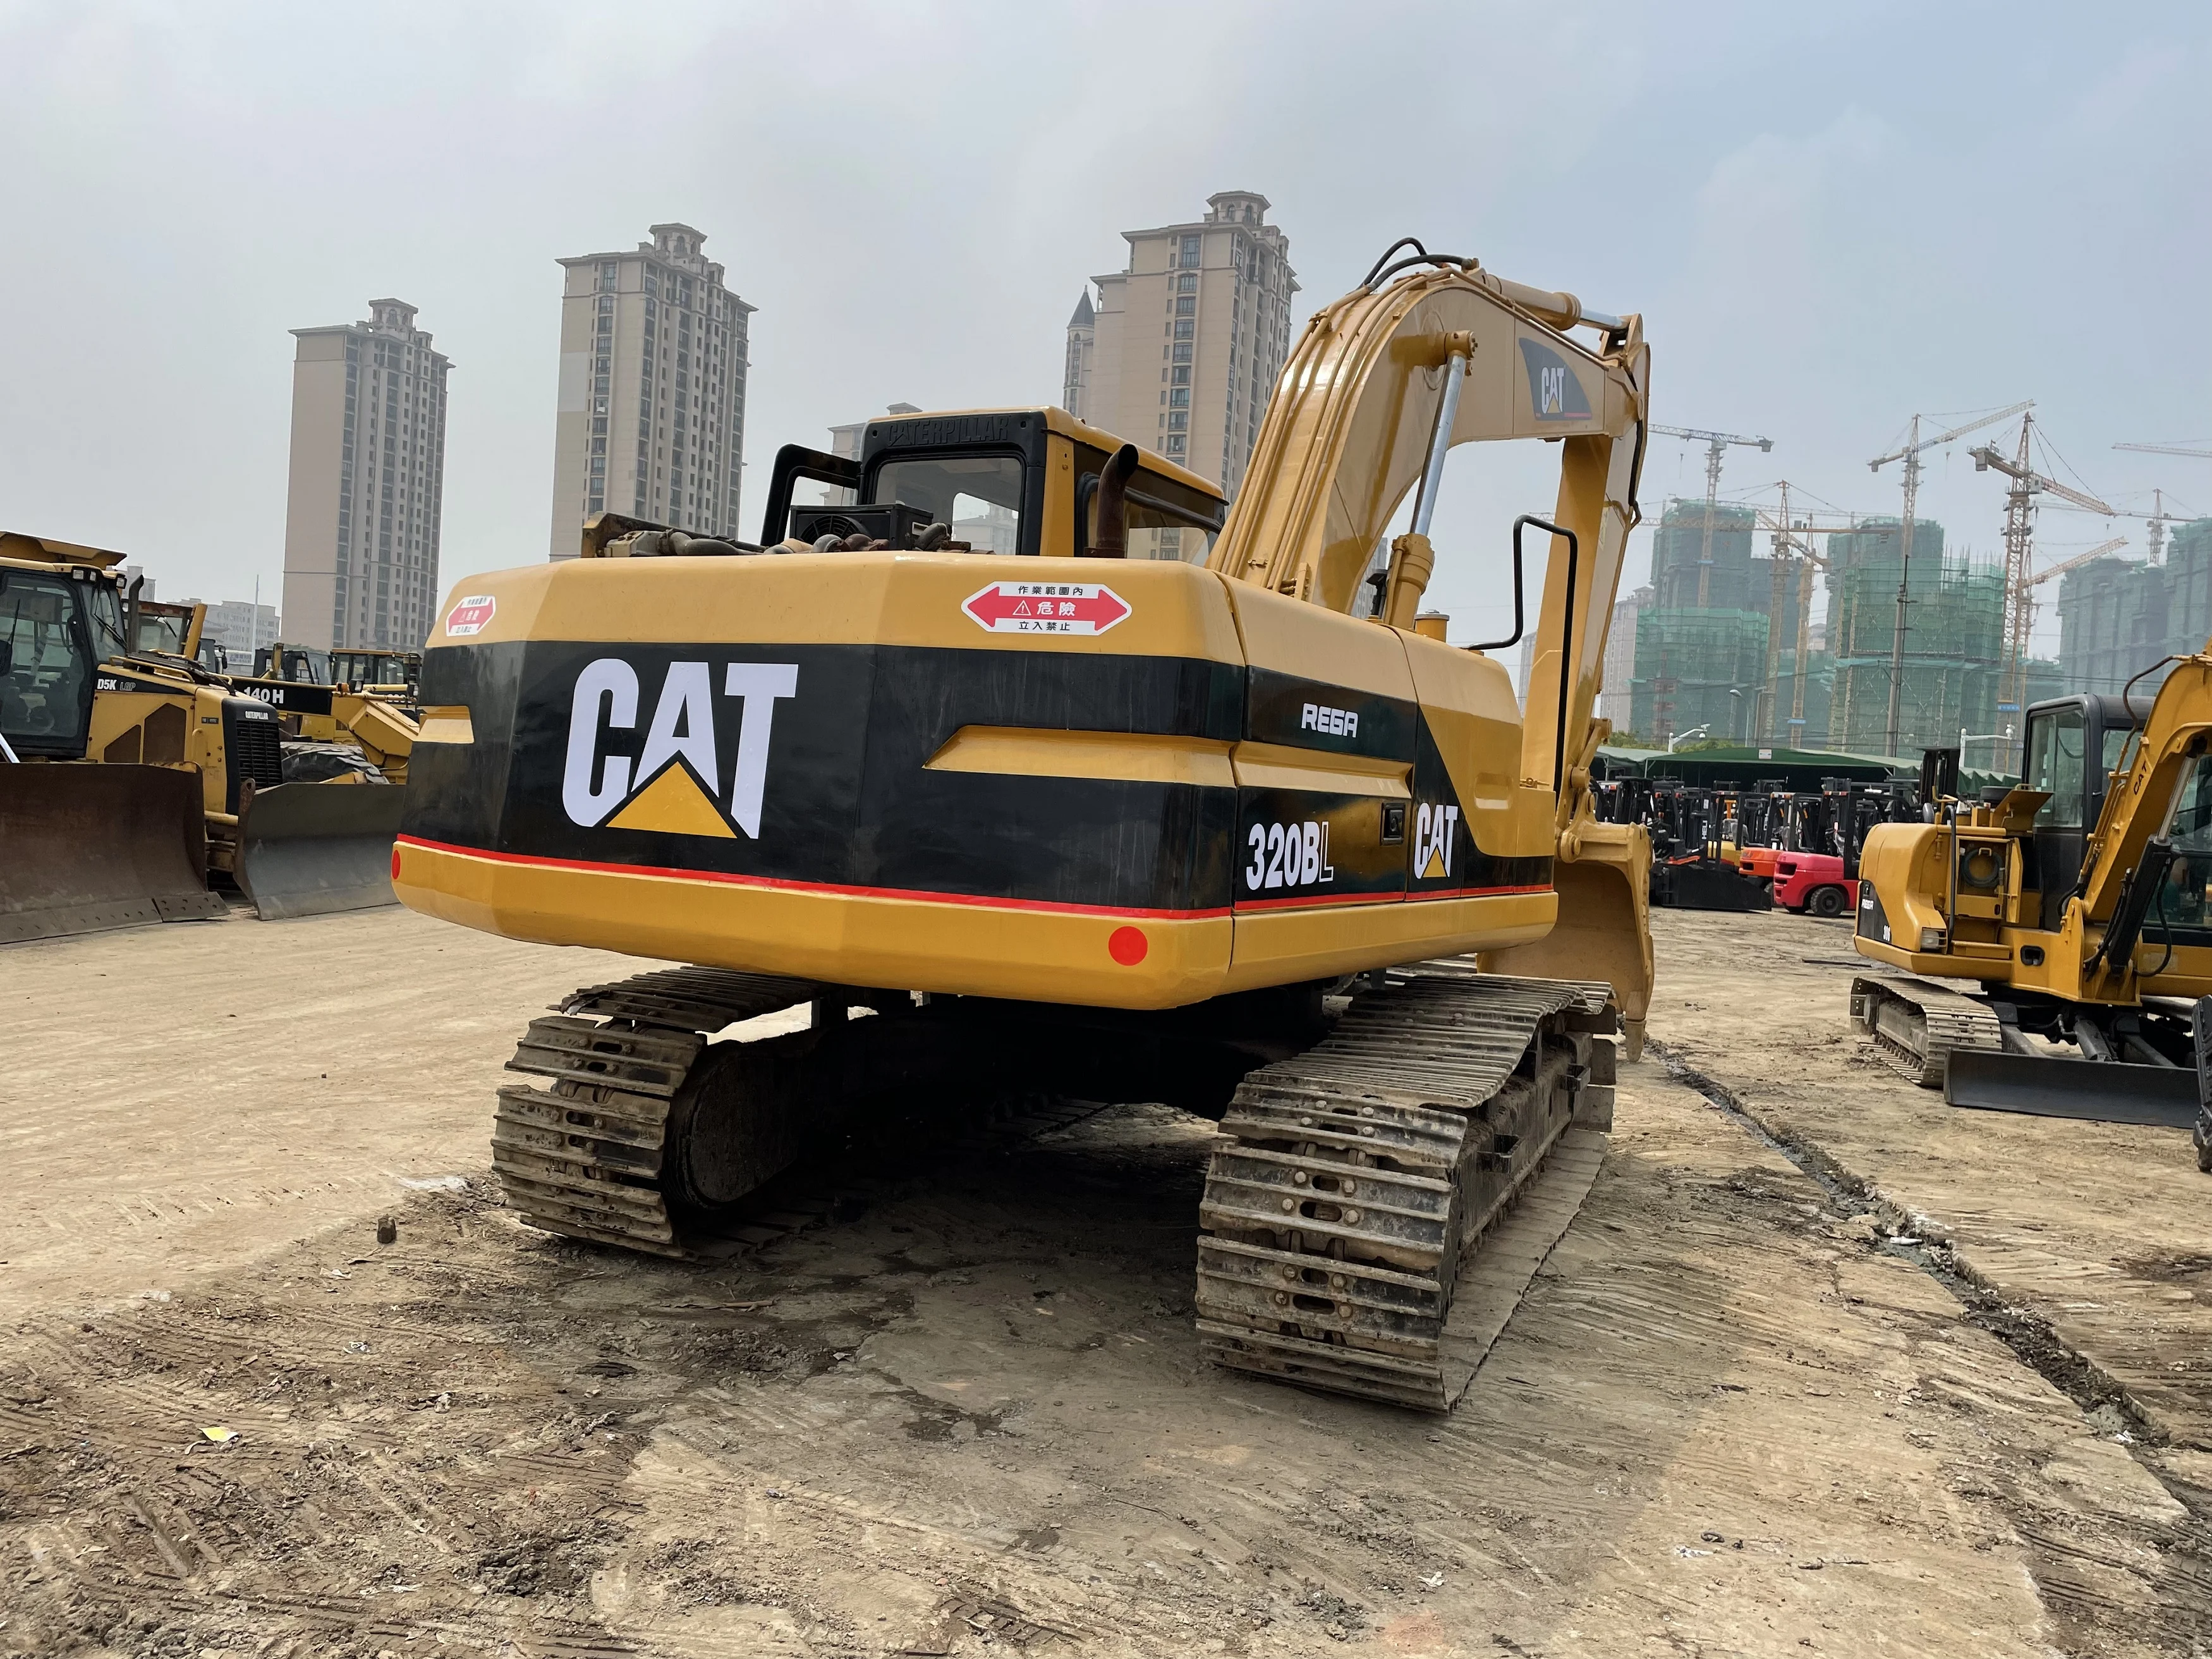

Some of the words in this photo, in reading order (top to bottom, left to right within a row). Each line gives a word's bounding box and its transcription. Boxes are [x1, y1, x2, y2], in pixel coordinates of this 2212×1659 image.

[1541, 367, 1564, 413] CAT
[888, 415, 1010, 447] CATERPILLAR
[1018, 621, 1070, 631] 立入禁止
[1036, 601, 1076, 616] 危險
[97, 679, 117, 690] D5K
[1301, 703, 1359, 738] REGA
[562, 658, 799, 839] CAT
[2134, 760, 2146, 795] CAT
[1246, 822, 1334, 890] 320BL
[1414, 803, 1458, 879] CAT
